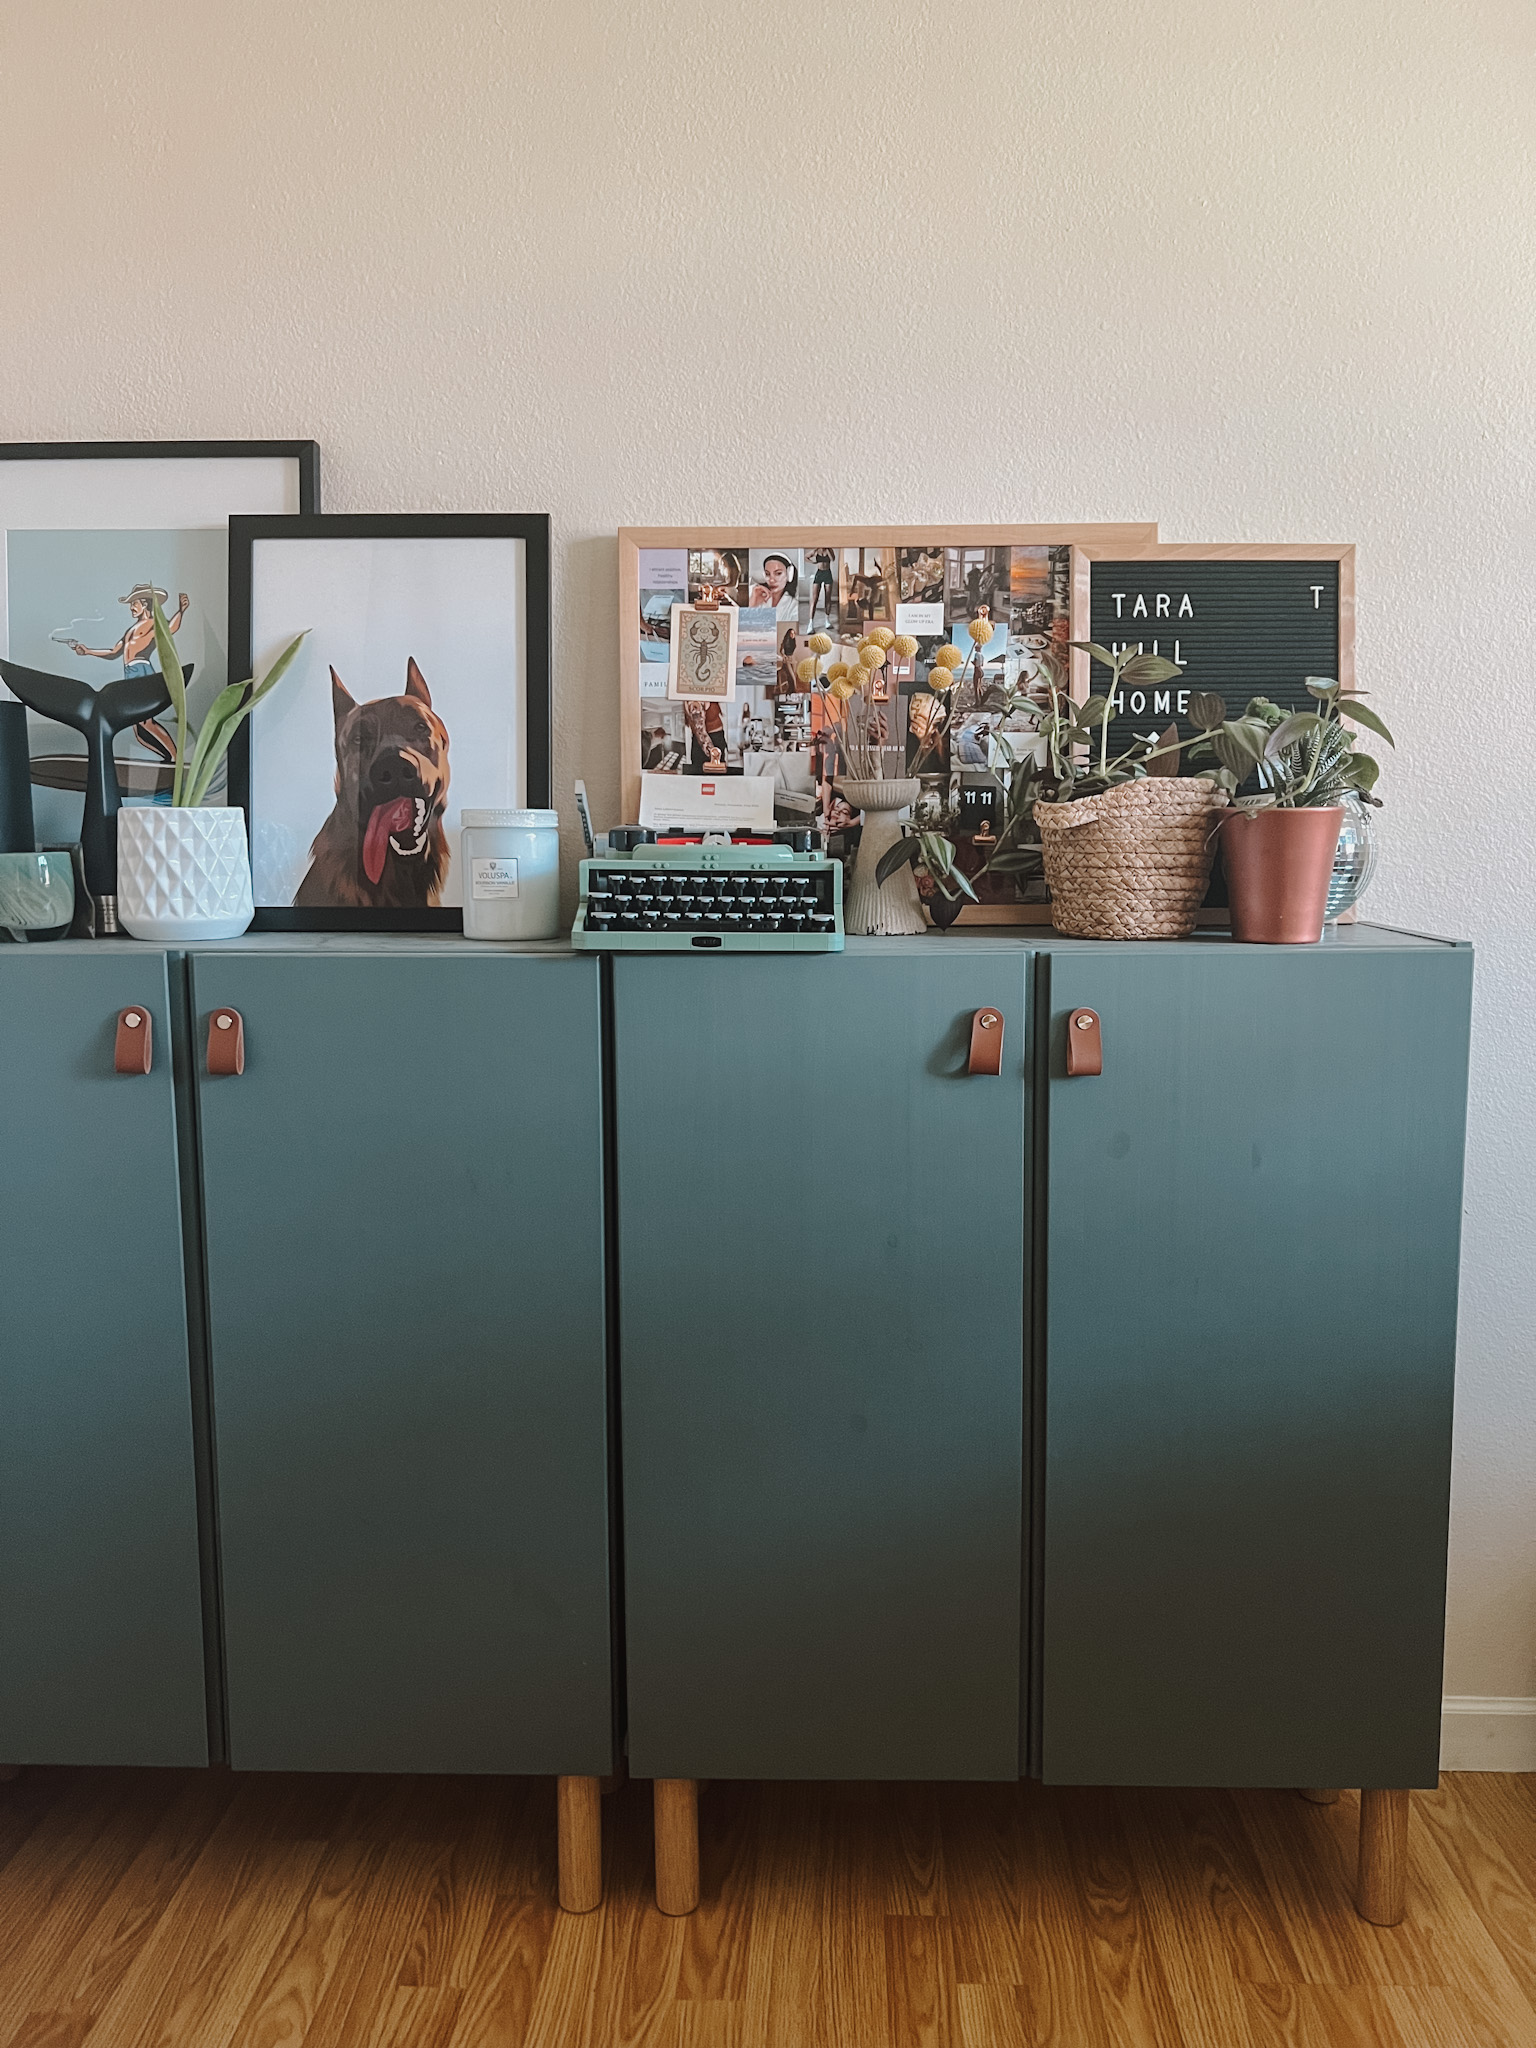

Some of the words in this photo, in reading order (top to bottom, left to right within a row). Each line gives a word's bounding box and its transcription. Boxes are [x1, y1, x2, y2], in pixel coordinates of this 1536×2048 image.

[1111, 593, 1194, 618] TARA
[1309, 586, 1324, 609] T
[1110, 690, 1191, 715] HOME
[980, 792, 992, 805] 11
